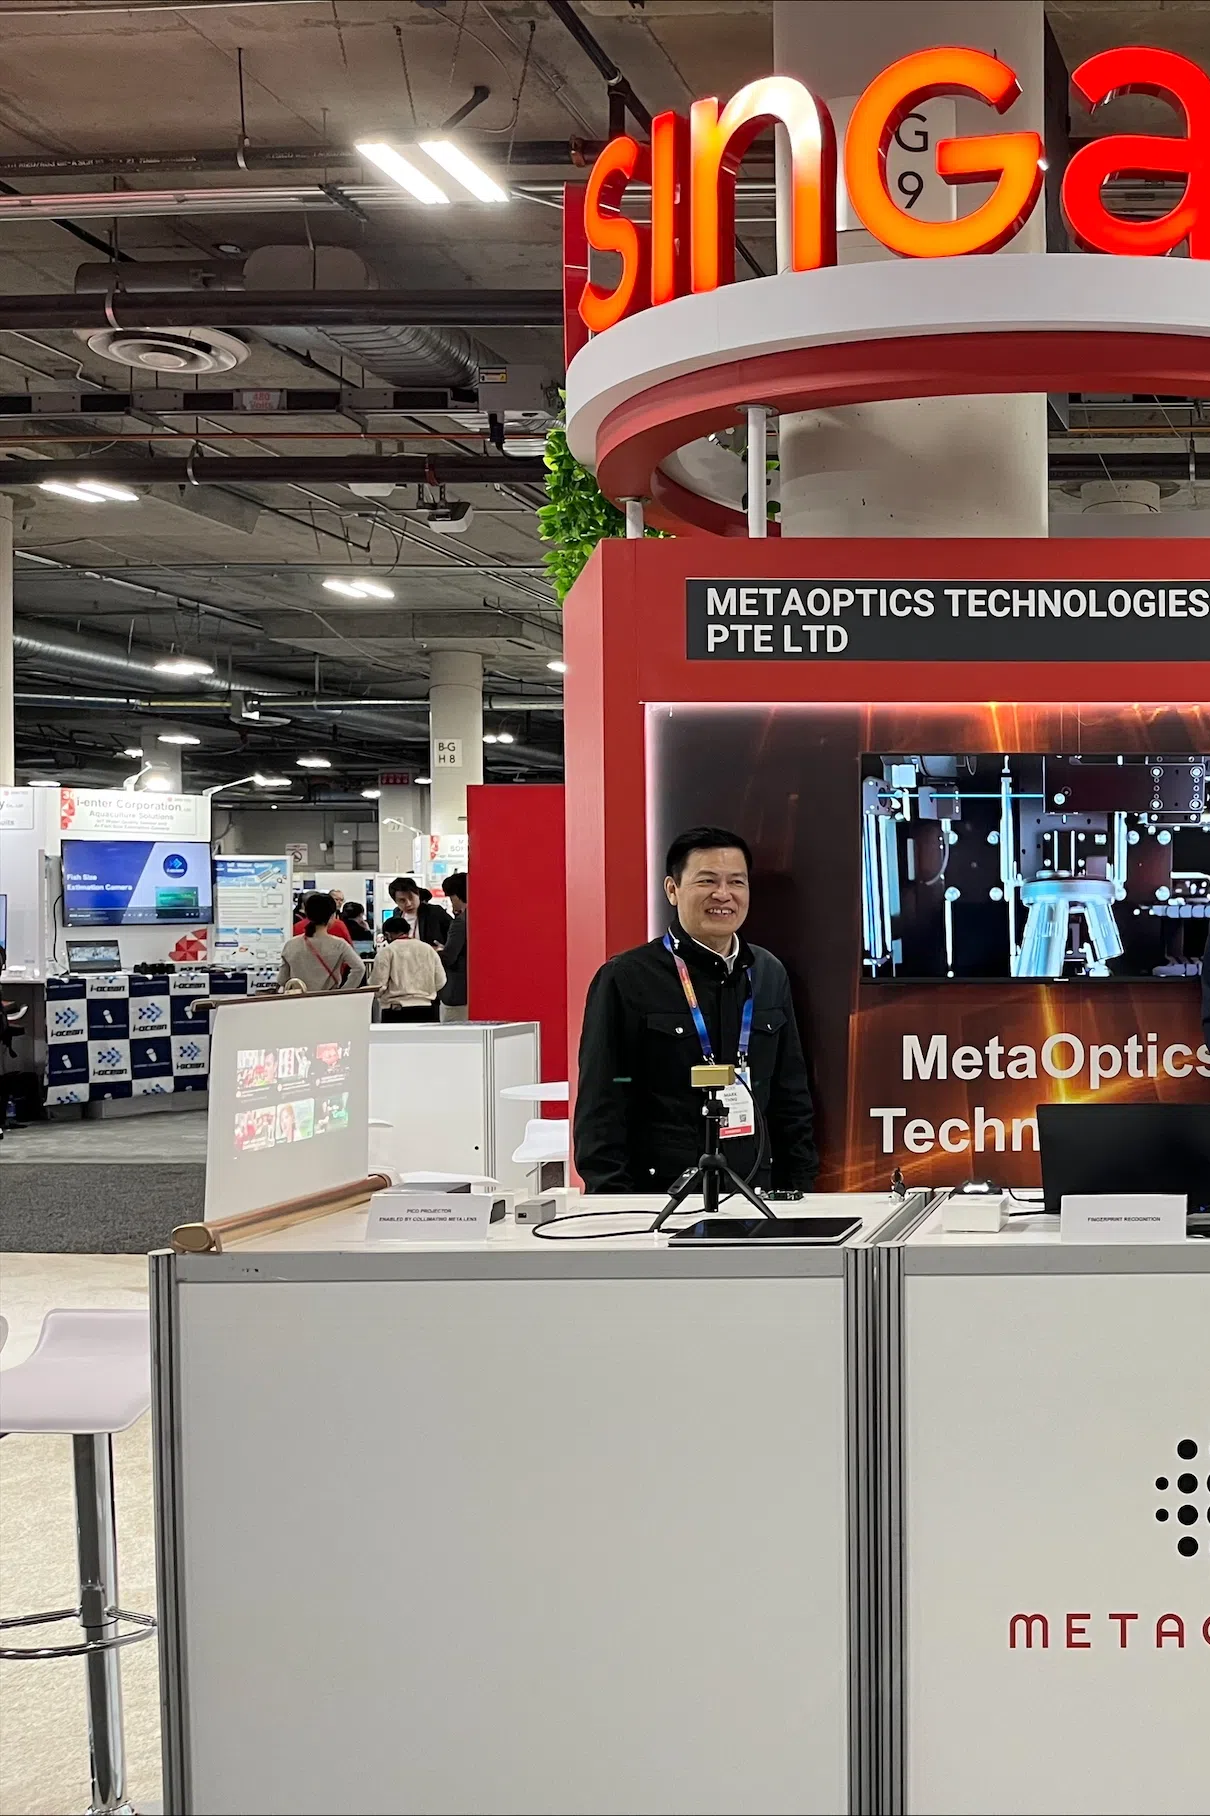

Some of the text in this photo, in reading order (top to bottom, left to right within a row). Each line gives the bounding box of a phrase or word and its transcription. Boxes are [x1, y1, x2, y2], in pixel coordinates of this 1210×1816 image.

[898, 171, 924, 208] 9
[706, 587, 1210, 618] METAOPTICS TECHNOLOGIES
[706, 624, 849, 653] PTE LTD
[438, 742, 456, 751] B-G
[438, 755, 456, 763] H 8
[116, 799, 182, 812] Corporation
